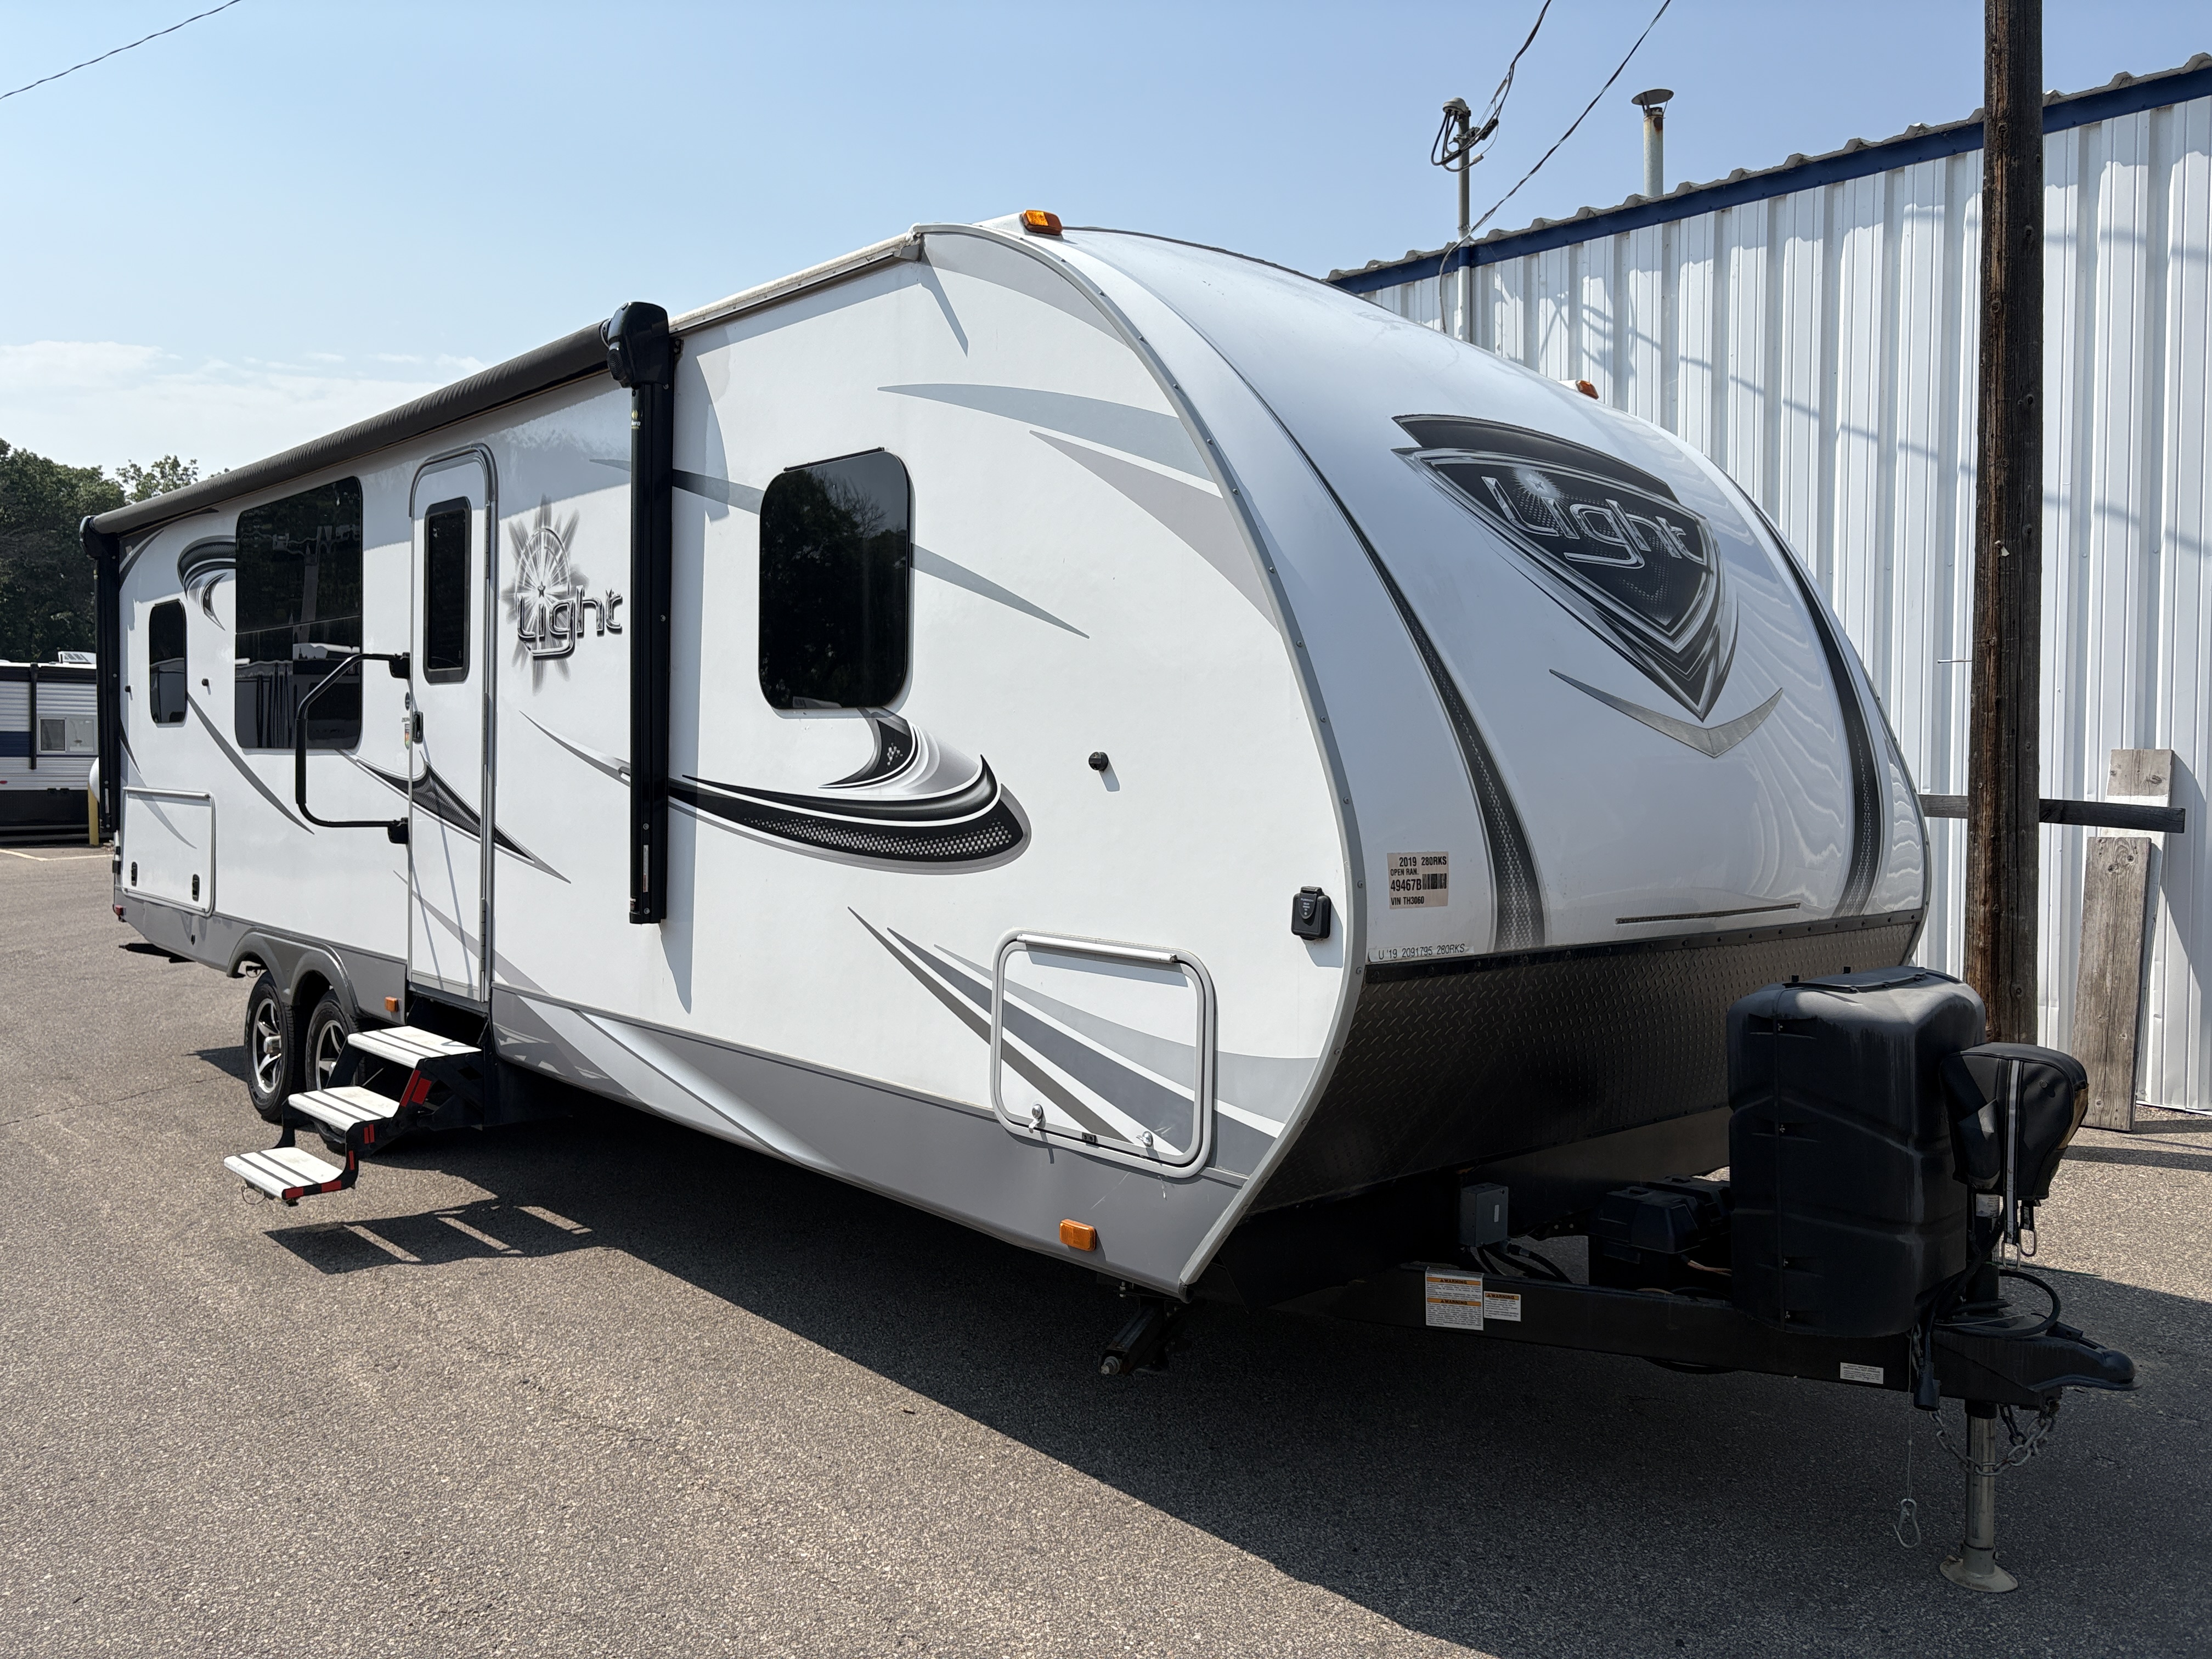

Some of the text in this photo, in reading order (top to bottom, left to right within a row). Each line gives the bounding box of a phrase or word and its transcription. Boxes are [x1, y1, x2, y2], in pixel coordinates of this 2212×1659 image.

[1481, 476, 1708, 569] Light
[517, 585, 623, 659] Light
[1399, 856, 1447, 867] 2019 280RKS
[1390, 868, 1404, 876] OPEN
[1390, 878, 1422, 891] 49467B
[1390, 896, 1425, 906] VIN TH3060
[1378, 944, 1465, 960] U '19 2091795 280RKS
